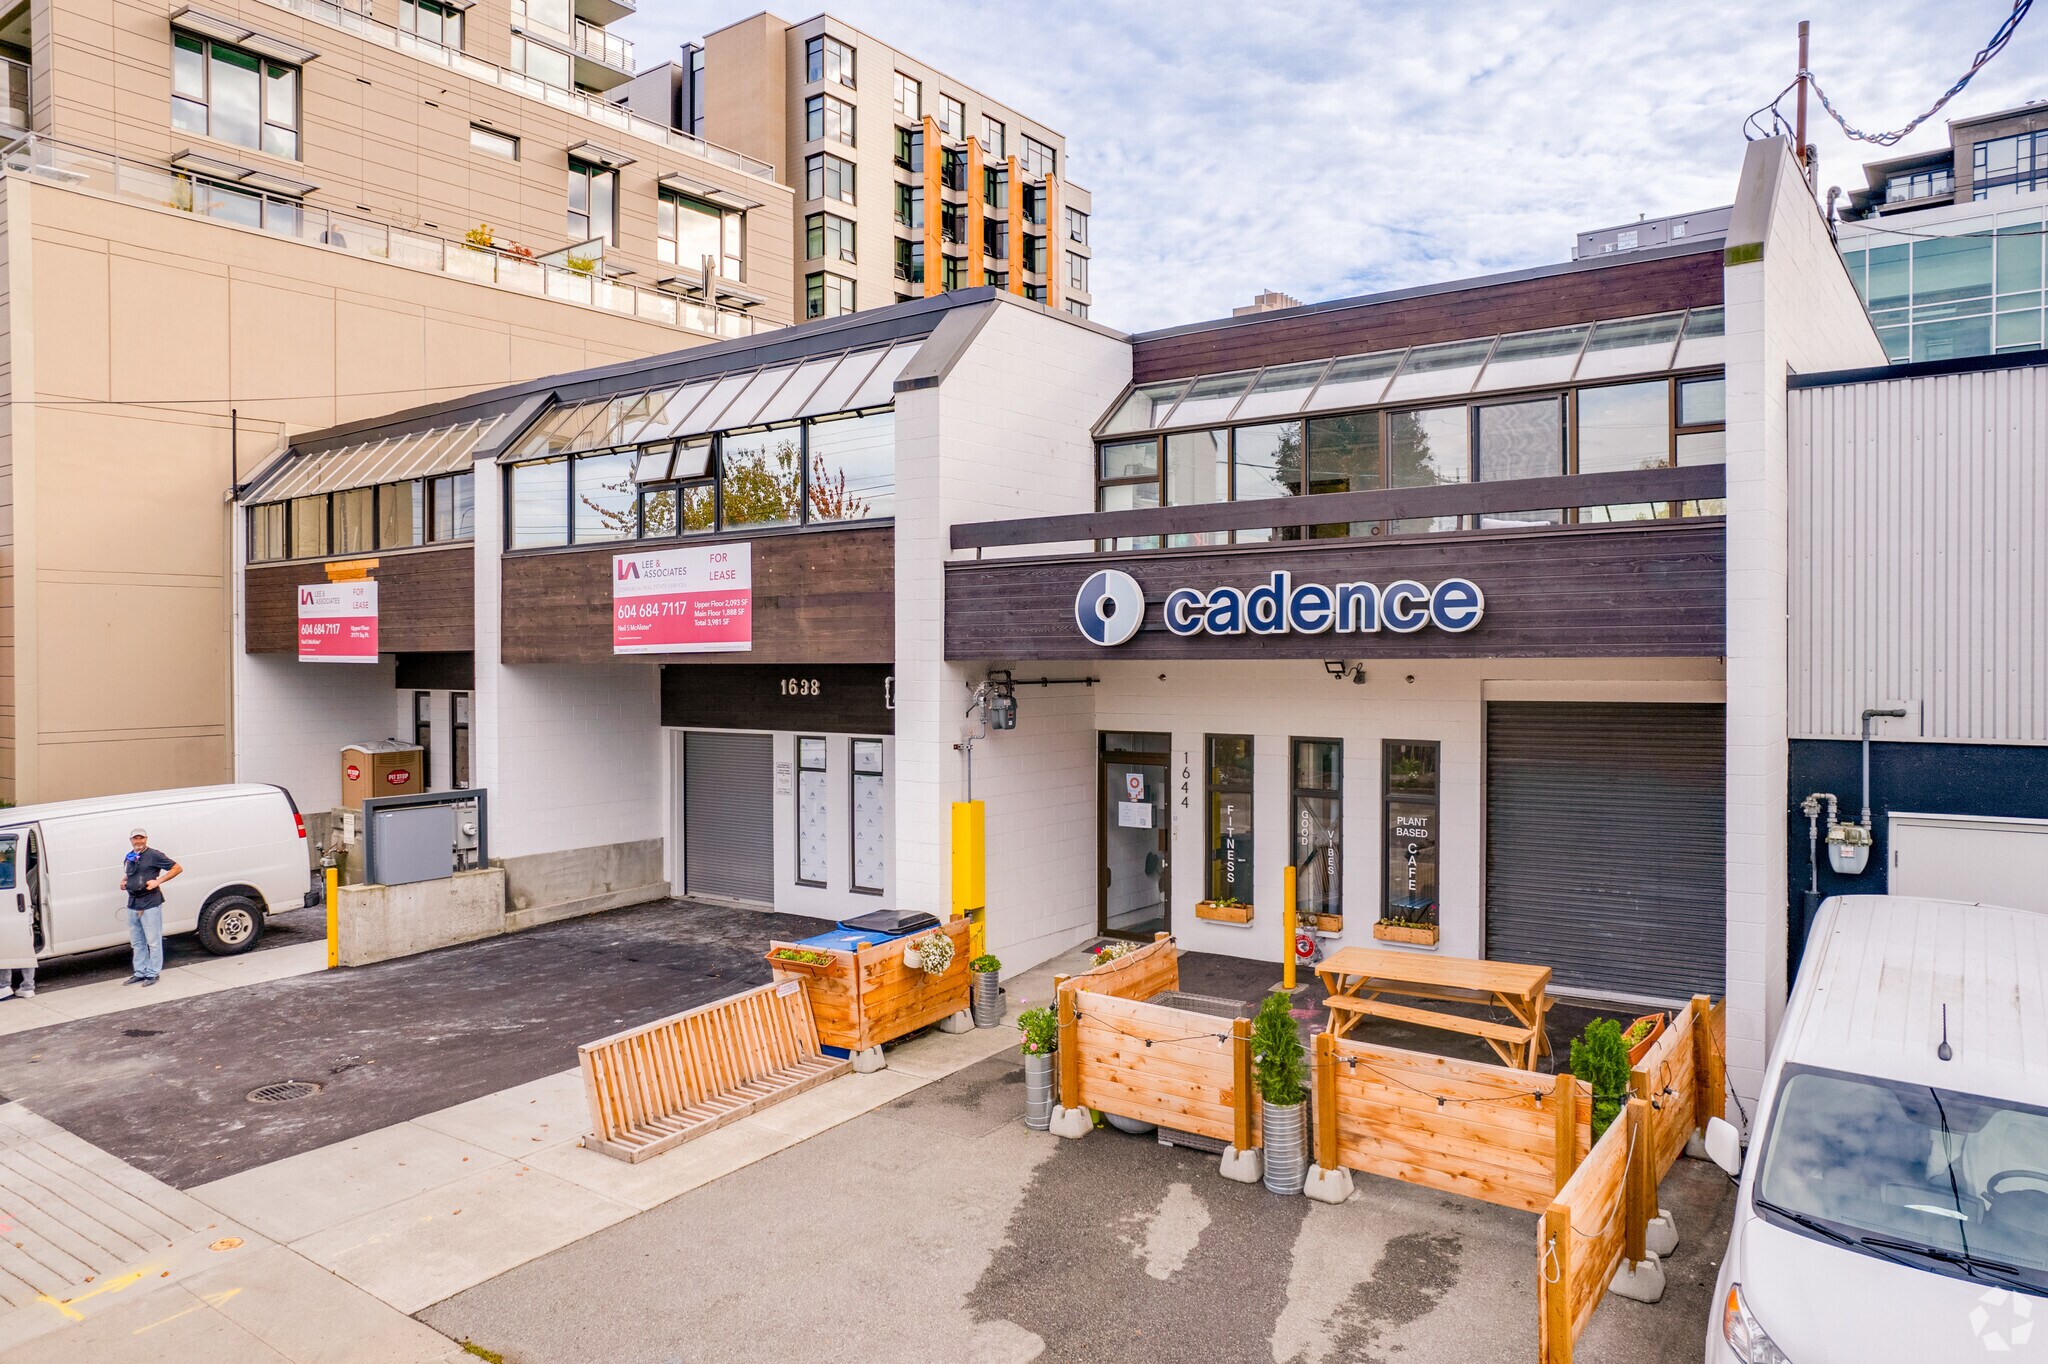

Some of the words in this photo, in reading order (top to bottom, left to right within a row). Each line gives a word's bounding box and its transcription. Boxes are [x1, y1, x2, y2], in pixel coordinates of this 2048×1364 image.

[641, 560, 654, 569] LEE
[655, 559, 661, 568] &
[709, 553, 728, 563] FOR
[644, 567, 687, 579] ASSOCIATES
[709, 569, 736, 581] LEASE
[353, 588, 365, 596] FOR
[316, 597, 340, 605] ASSOCIATES
[353, 601, 369, 609] LEASE
[694, 601, 710, 609] Upper
[725, 599, 740, 607] 2,093
[741, 598, 749, 606] SF
[1164, 570, 1484, 636] cadence
[618, 604, 636, 619] 604
[639, 603, 659, 618] 684
[662, 601, 687, 616] 7117
[617, 624, 626, 632] Neil
[694, 619, 706, 627] Total
[707, 618, 721, 627] 3,981
[301, 624, 313, 635] 604
[314, 624, 325, 635] 684
[326, 623, 340, 635] 7117
[780, 678, 820, 696] 1638
[1180, 752, 1190, 809] 1644
[1397, 816, 1428, 827] PLANT
[1301, 810, 1309, 846] GOOD
[1396, 827, 1428, 838] BASED
[1227, 805, 1235, 883] FITNESS
[1327, 830, 1335, 875] VIBES
[1407, 843, 1417, 891] CAFE
